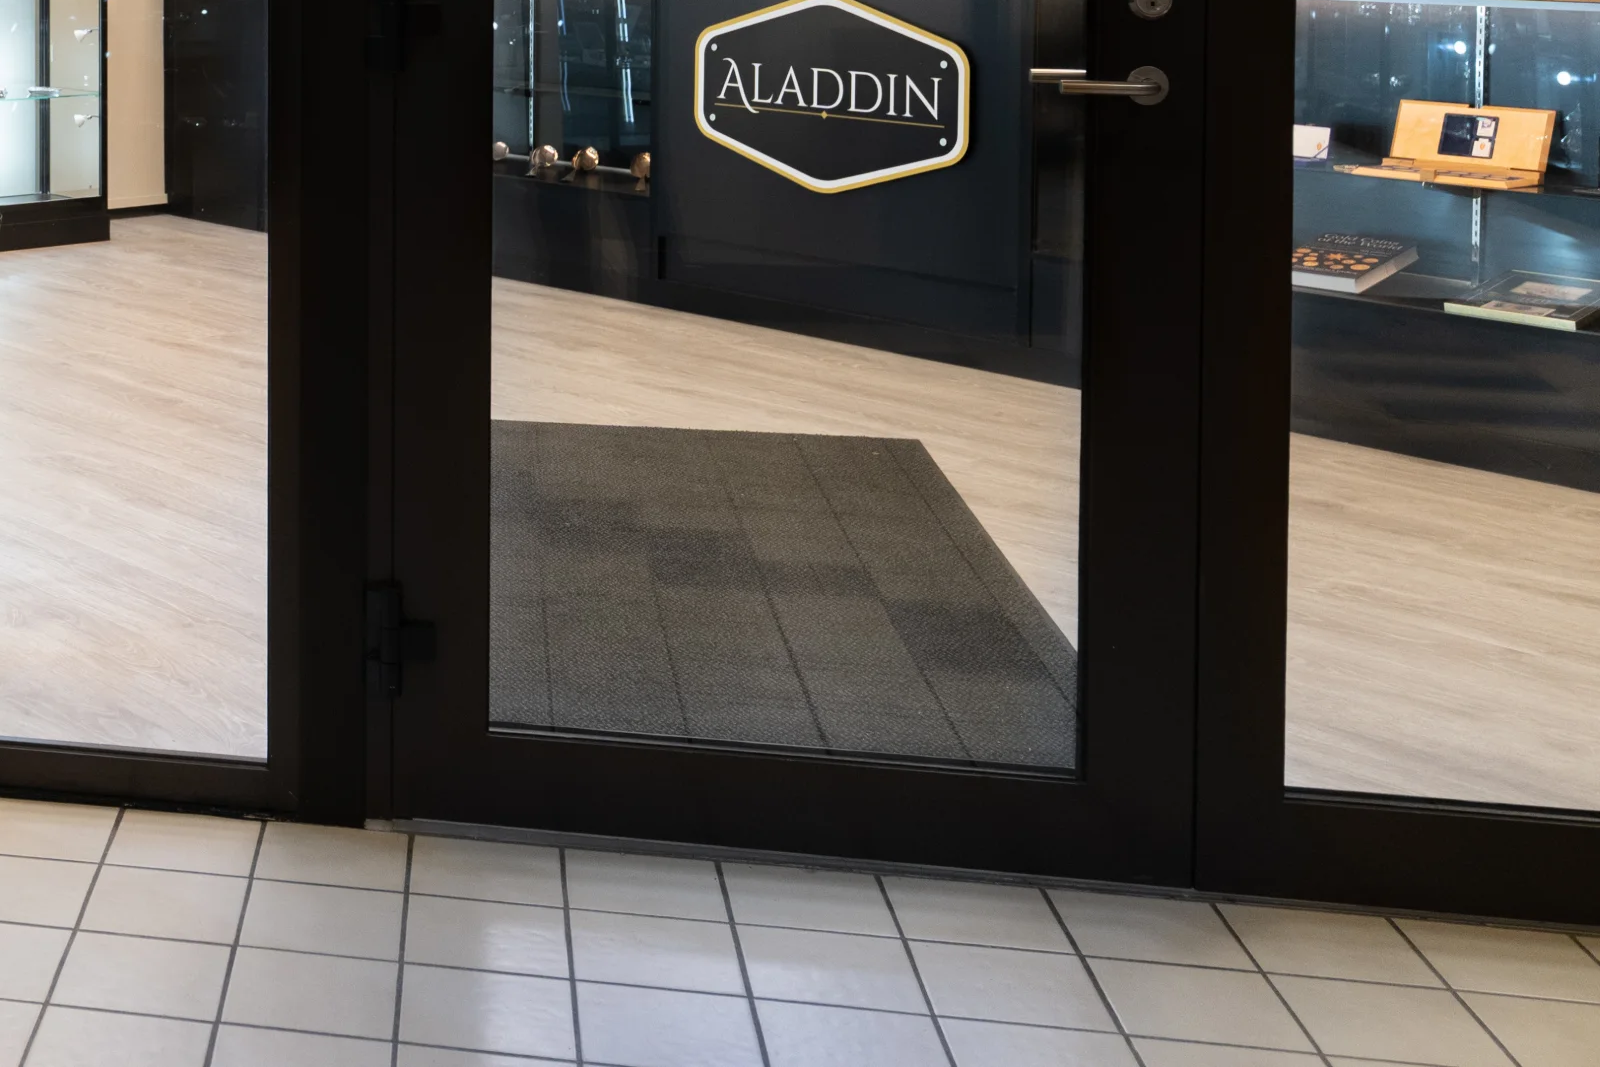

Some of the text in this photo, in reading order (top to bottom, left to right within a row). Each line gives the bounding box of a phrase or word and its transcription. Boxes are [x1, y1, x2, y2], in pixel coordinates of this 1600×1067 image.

[716, 57, 943, 121] ALADDIN
[1324, 233, 1400, 246] Gold Coins
